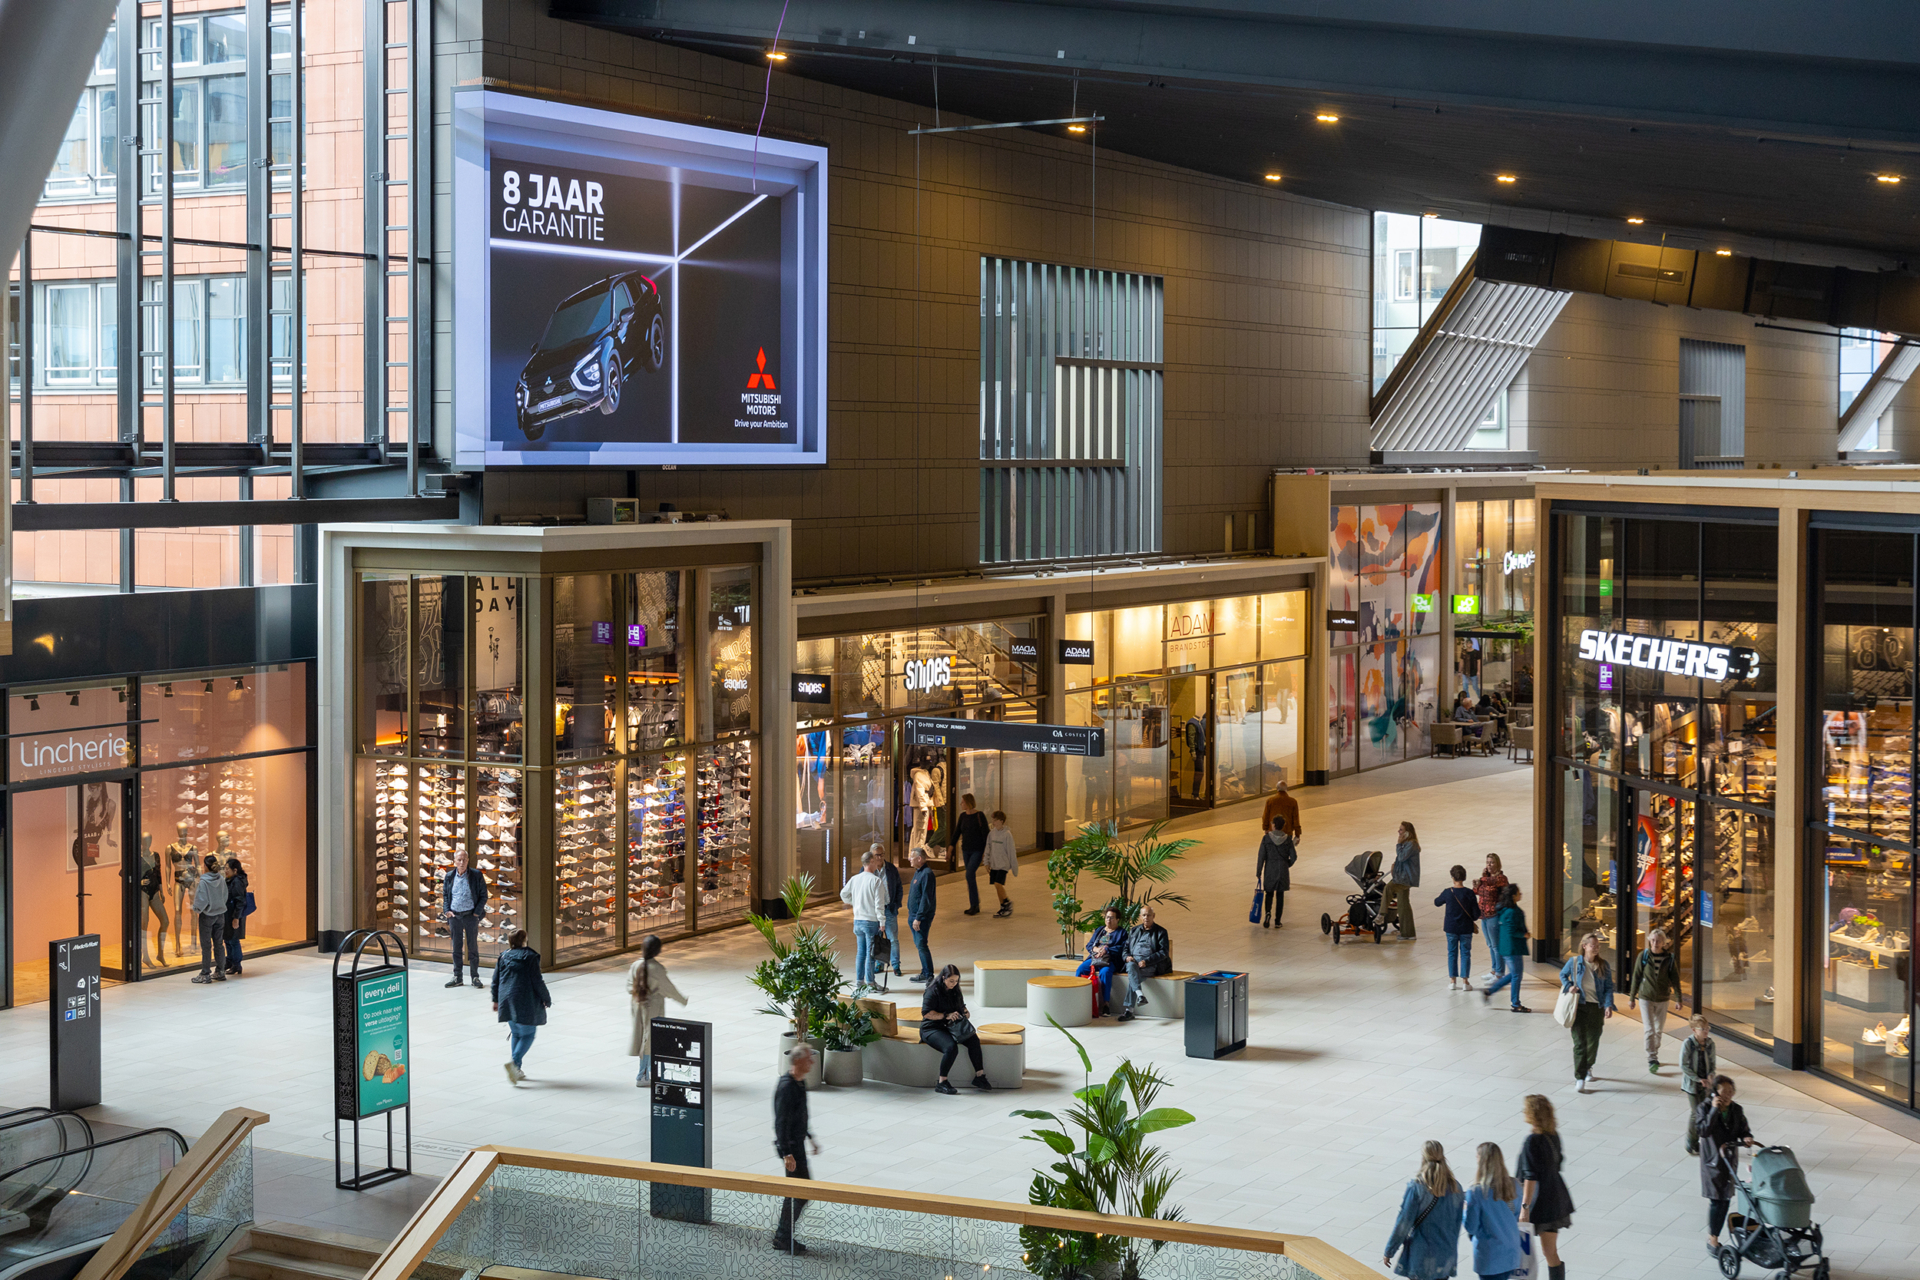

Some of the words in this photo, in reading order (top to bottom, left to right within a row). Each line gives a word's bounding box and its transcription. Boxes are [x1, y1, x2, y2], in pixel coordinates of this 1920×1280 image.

[503, 170, 521, 205] 8
[528, 173, 604, 215] JAAR
[503, 207, 604, 241] GARANTIE
[741, 393, 782, 404] MITSUBISHI
[746, 405, 777, 415] MOTORS
[734, 419, 749, 428] Drive
[750, 421, 763, 430] your
[763, 420, 789, 428] Ambition
[1170, 612, 1215, 637] ADAM
[1065, 647, 1090, 655] ADAM
[1578, 629, 1731, 681] SKECHERS
[905, 656, 952, 694] snipes
[798, 682, 823, 695] snipes
[20, 733, 126, 767] Lincherie
[39, 765, 75, 775] LINGERIE
[78, 761, 111, 770] STYLISTS
[364, 982, 400, 999] every.deli
[363, 1012, 371, 1020] Op
[371, 1010, 382, 1018] zoek
[378, 1012, 401, 1024] uitdaging?
